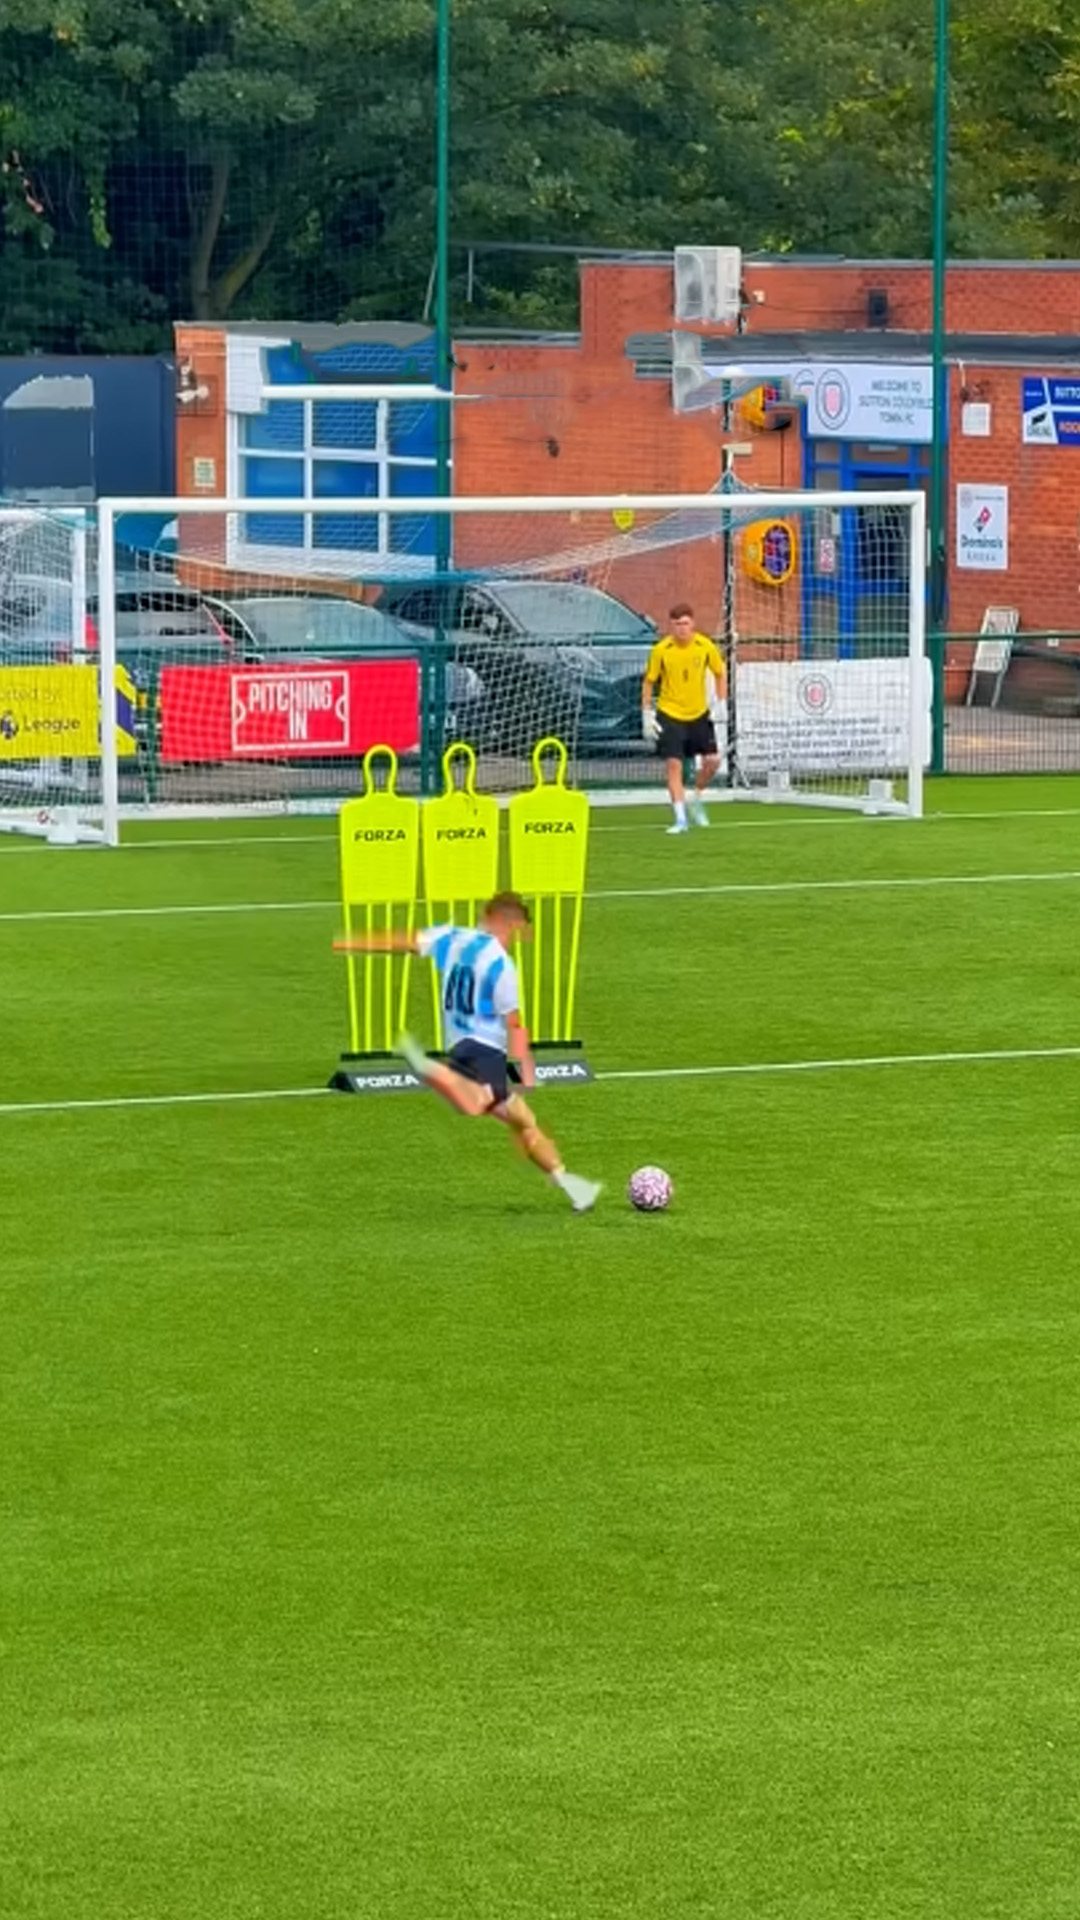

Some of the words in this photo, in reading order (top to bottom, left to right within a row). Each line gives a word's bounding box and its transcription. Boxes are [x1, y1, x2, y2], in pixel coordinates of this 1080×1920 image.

[870, 380, 908, 392] WELCOME
[911, 380, 923, 393] TO
[858, 395, 891, 407] SUTTON
[249, 680, 332, 712] PITCHING
[23, 714, 81, 735] League
[289, 706, 308, 740] IN
[436, 827, 487, 841] FORZA
[524, 821, 576, 834] FORZA
[354, 829, 406, 842] FORZA
[535, 1064, 588, 1079] ORZA
[356, 1074, 420, 1089] FORZA
